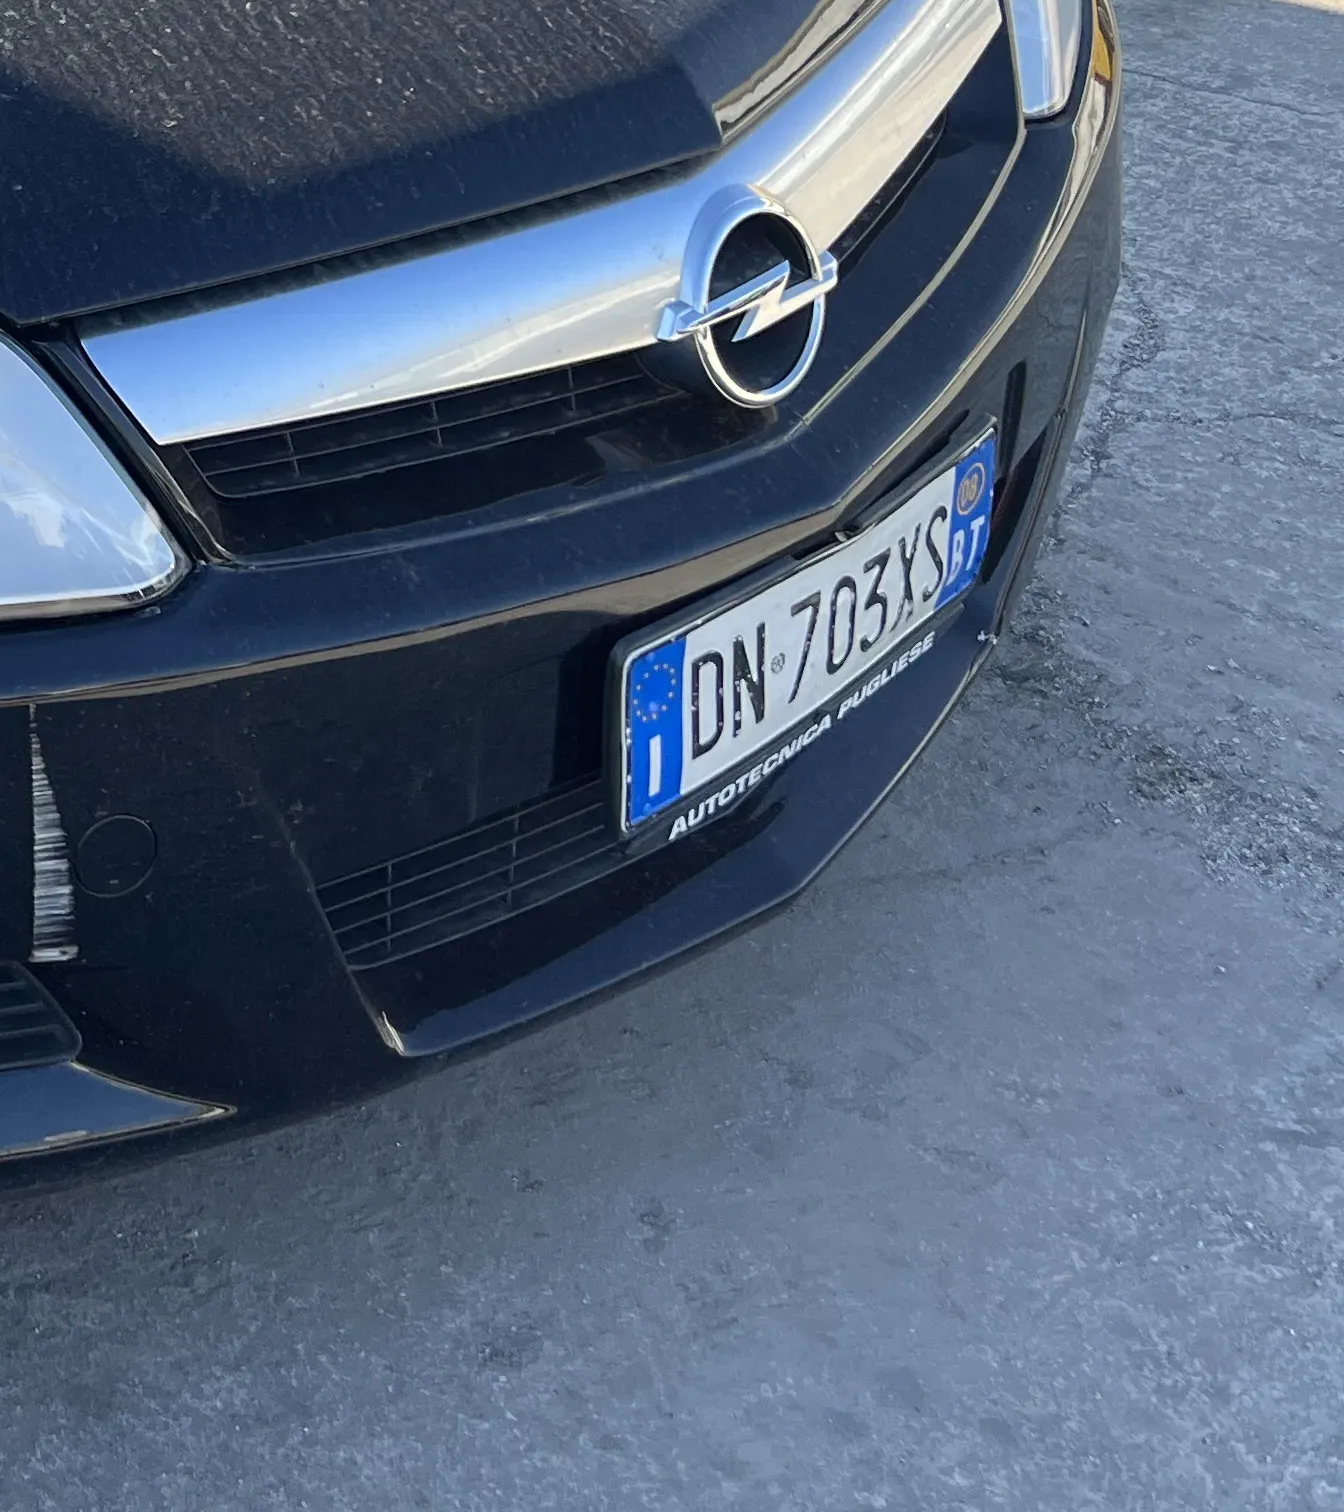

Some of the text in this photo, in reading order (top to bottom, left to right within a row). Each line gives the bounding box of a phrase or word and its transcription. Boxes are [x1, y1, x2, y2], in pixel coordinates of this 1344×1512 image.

[945, 514, 986, 587] BT
[668, 630, 937, 841] AUTOTECNICA PUGLIESE
